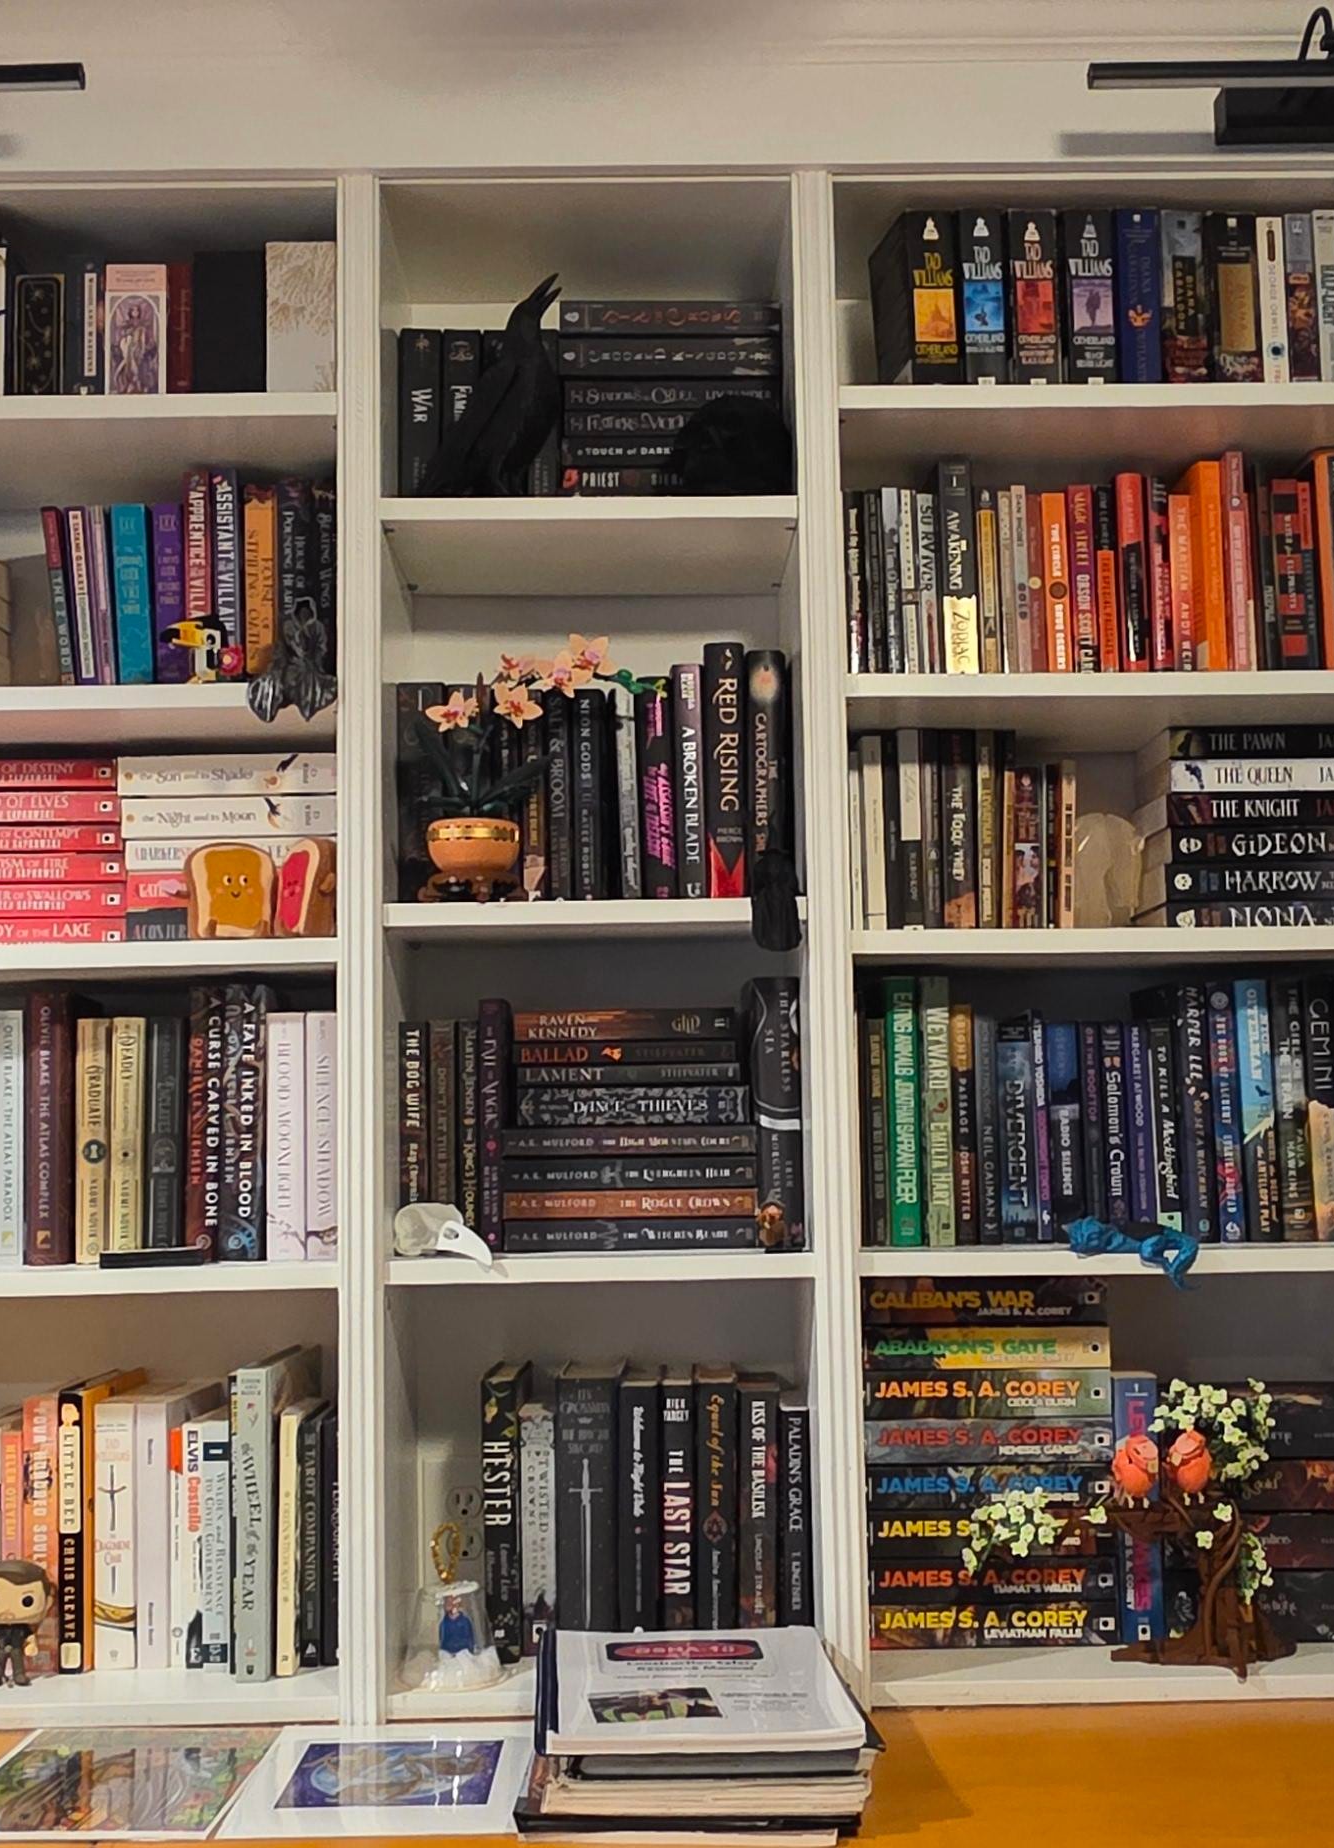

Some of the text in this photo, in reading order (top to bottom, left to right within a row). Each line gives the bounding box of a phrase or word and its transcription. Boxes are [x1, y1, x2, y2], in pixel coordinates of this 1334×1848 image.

[412, 389, 432, 422] WAR
[582, 473, 619, 487] PRIEST
[188, 491, 206, 566] APPRENTICE
[216, 485, 235, 559] ASSISTANT
[921, 505, 935, 591] SURVIVOR
[946, 510, 962, 589] AWAKENING
[952, 611, 971, 663] ZODIAC
[1, 763, 19, 774] OF
[22, 762, 75, 774] DESTINY
[712, 678, 739, 812] RED RISING
[755, 713, 767, 826] CARTOGRAPHERS
[1209, 734, 1240, 750] THE
[1244, 734, 1285, 750] PAWN
[7, 797, 25, 809] OF
[31, 796, 68, 807] ELVES
[551, 759, 564, 818] BROOM
[683, 727, 699, 864] A BROKEN BLADE
[1211, 800, 1240, 818] THE
[1244, 799, 1299, 817] KNIGHT
[1215, 767, 1242, 784] THE
[1247, 767, 1292, 785] QUEEN
[157, 812, 191, 827] Night
[222, 812, 256, 821] Moon
[27, 889, 91, 900] SWALLOWS
[1226, 871, 1322, 893] HARROW
[1228, 906, 1316, 926] NONA
[528, 1027, 596, 1038] KENNEDY
[539, 1015, 585, 1026] RAVEN
[764, 1029, 774, 1053] SEA
[927, 1006, 949, 1089] WEYWARD
[1309, 1000, 1331, 1090] GEMINI
[407, 1030, 420, 1128] THE BOG WIFE
[521, 1048, 588, 1062] BALLAD
[526, 1068, 604, 1082] LAMENT
[205, 997, 220, 1226] A CURSE CARVED IN BONE
[239, 1002, 254, 1217] A FATE INKED IN BLOOD
[959, 1078, 968, 1134] PASSAGE
[1106, 1071, 1123, 1196] Solomon's Crown
[930, 1122, 951, 1206] EMILIA HART
[984, 1126, 995, 1217] NEIL GAIMAN
[1006, 1080, 1027, 1207] DIVERGENT
[1287, 1141, 1297, 1198] HAWKINS
[870, 1291, 1034, 1310] CALIBAN'S WAR
[874, 1339, 1057, 1356] ABADDON'S GATE
[875, 1381, 948, 1398] JAMES
[1005, 1380, 1080, 1396] COREY
[63, 1434, 75, 1526] LITTLE BEE
[188, 1430, 200, 1532] ELVIS Costello
[707, 1394, 724, 1506] Equal of the Sun
[752, 1401, 765, 1518] KISS OF THE BASILISK
[788, 1417, 802, 1532] PALADIN'S GRACE
[483, 1441, 511, 1526] HESTER
[538, 1460, 549, 1533] TWISTED
[304, 1450, 316, 1592] TAROT COMPANION
[663, 1451, 690, 1595] THE LAST STAR
[878, 1521, 951, 1537] JAMES
[63, 1539, 75, 1639] CHRIS CLEAVE
[880, 1612, 954, 1629] JAMES
[1011, 1611, 1086, 1627] COREY
